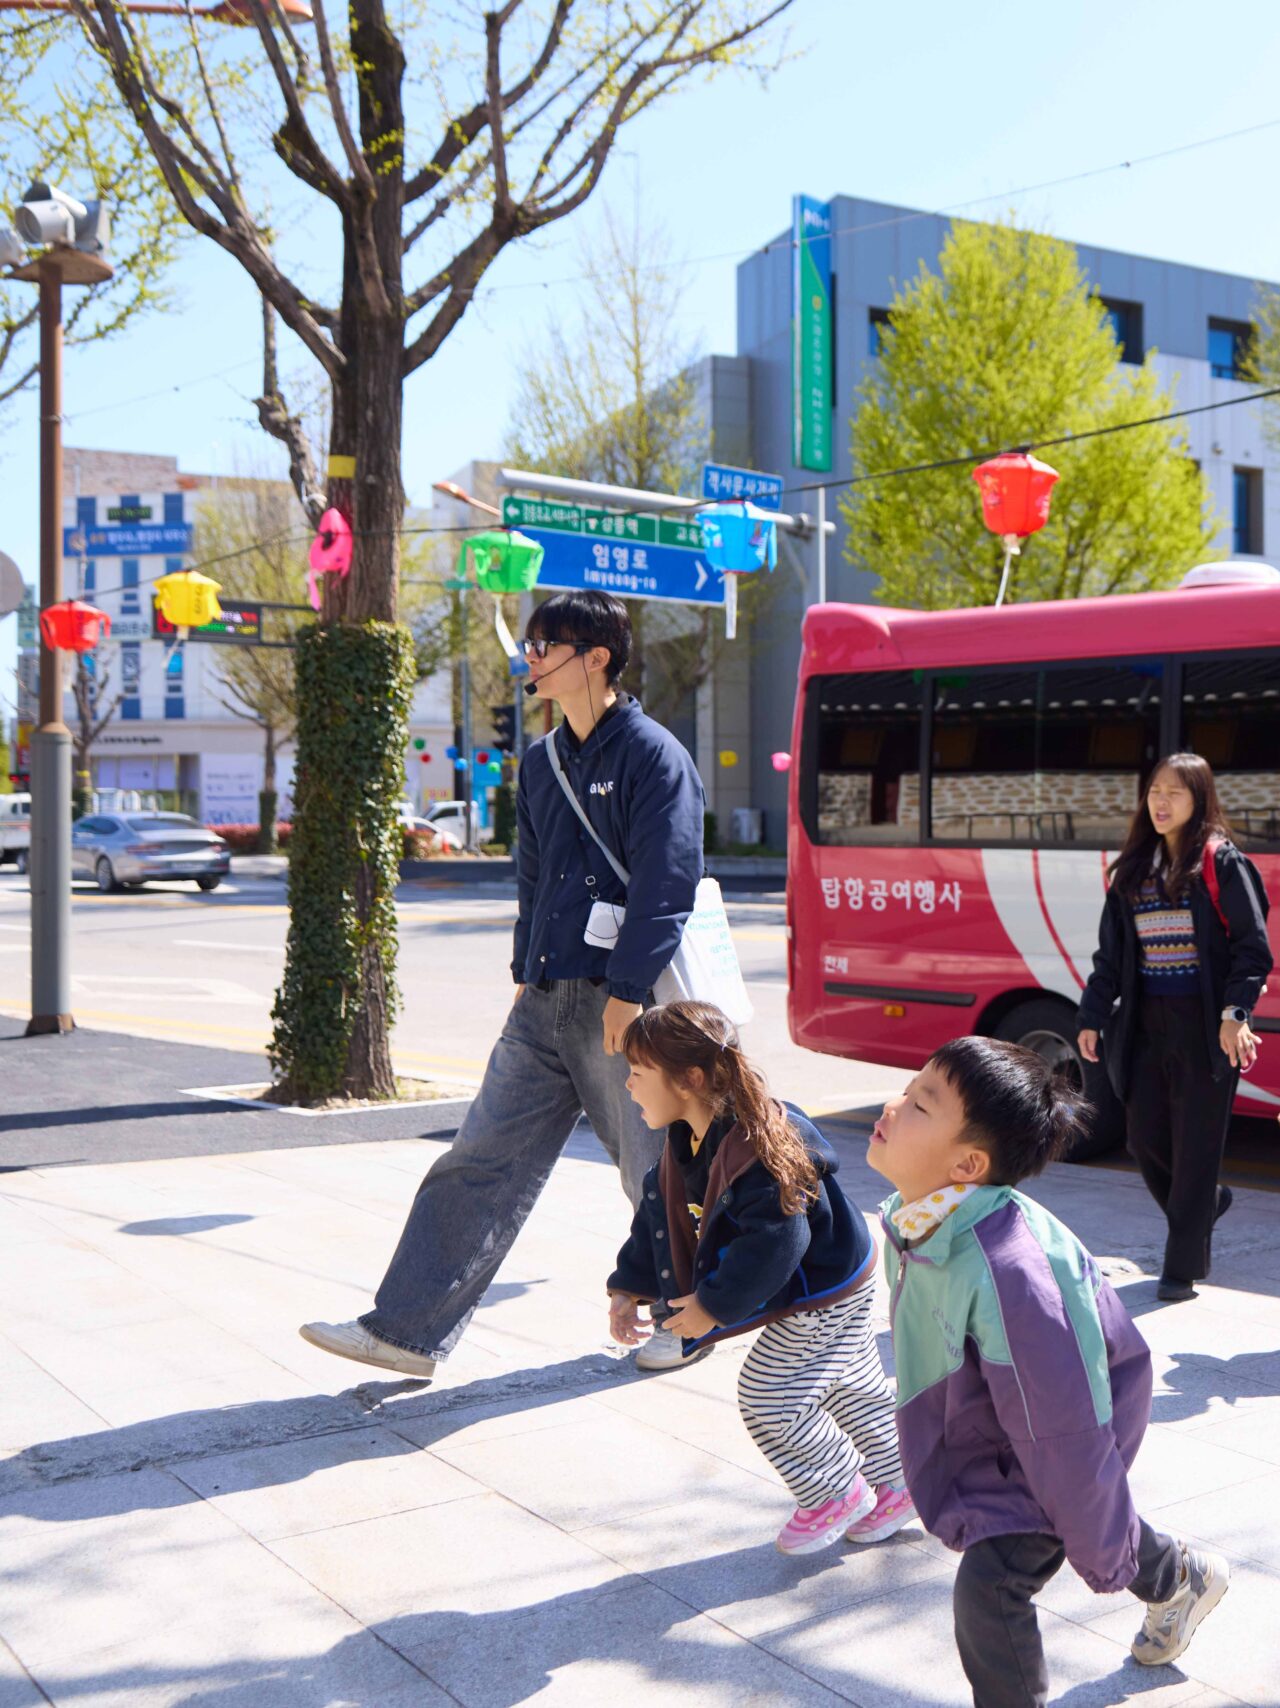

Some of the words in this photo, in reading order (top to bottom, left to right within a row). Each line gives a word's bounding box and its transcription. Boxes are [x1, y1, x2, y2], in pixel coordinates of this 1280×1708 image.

[592, 543, 649, 572] 임영로
[584, 567, 658, 591] Imyeong-ro
[820, 877, 963, 914] 탑항공여행사
[823, 954, 849, 975] 전세
